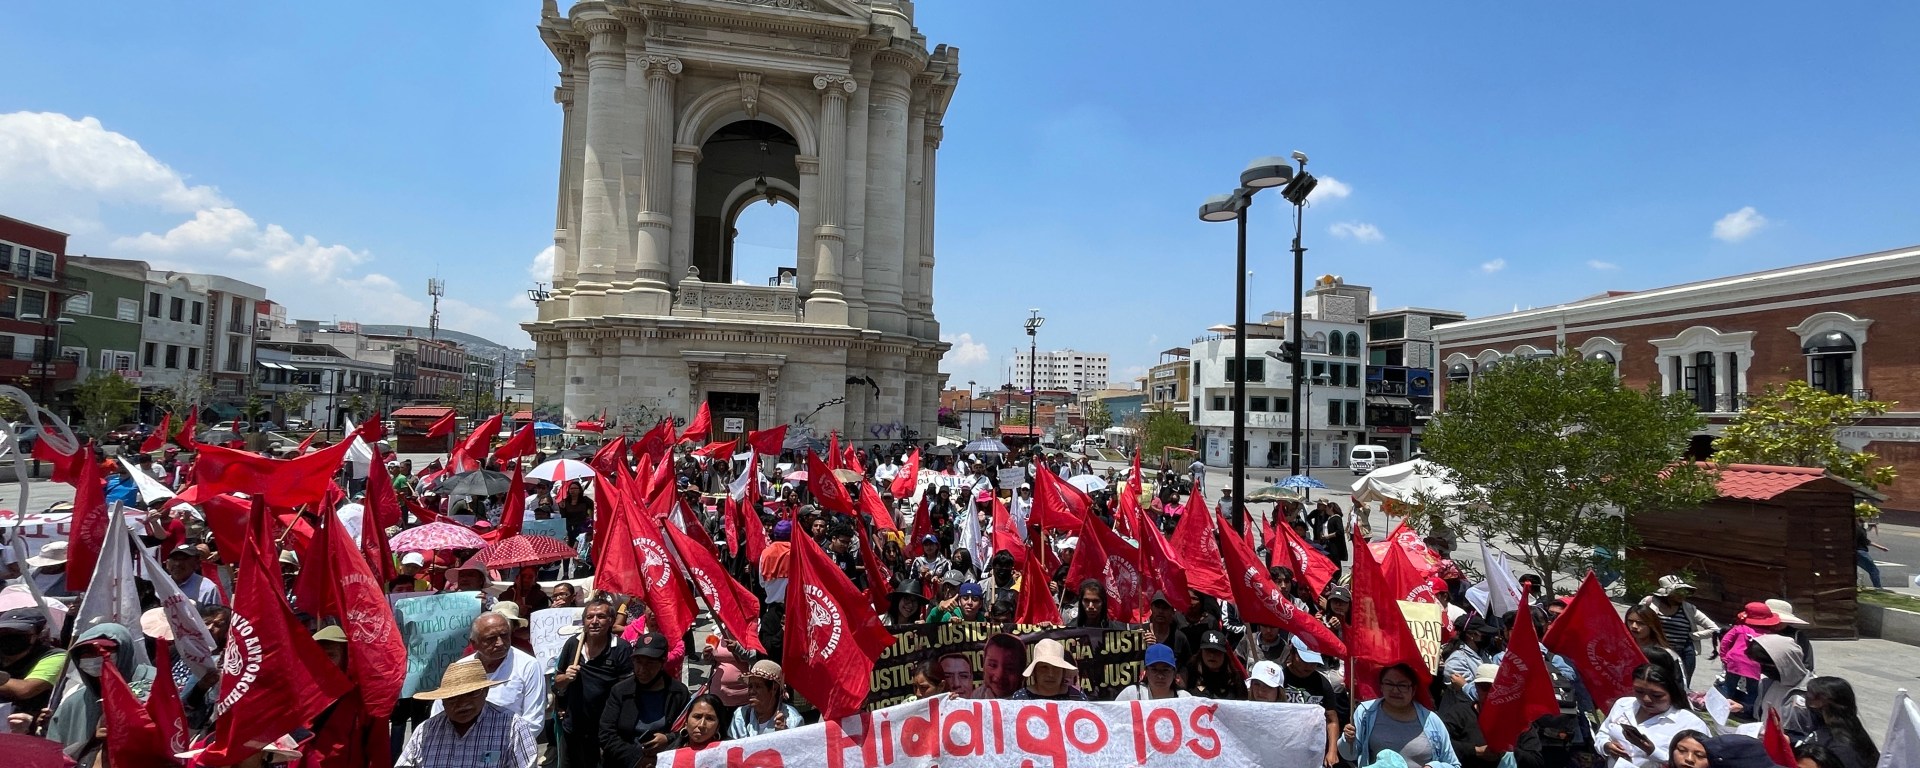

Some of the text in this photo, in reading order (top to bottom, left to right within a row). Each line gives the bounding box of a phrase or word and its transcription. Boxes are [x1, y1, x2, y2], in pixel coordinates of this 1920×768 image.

[820, 596, 842, 659] ANTORCHISTA
[825, 697, 1109, 768] Hidalgo
[1130, 700, 1222, 765] los
